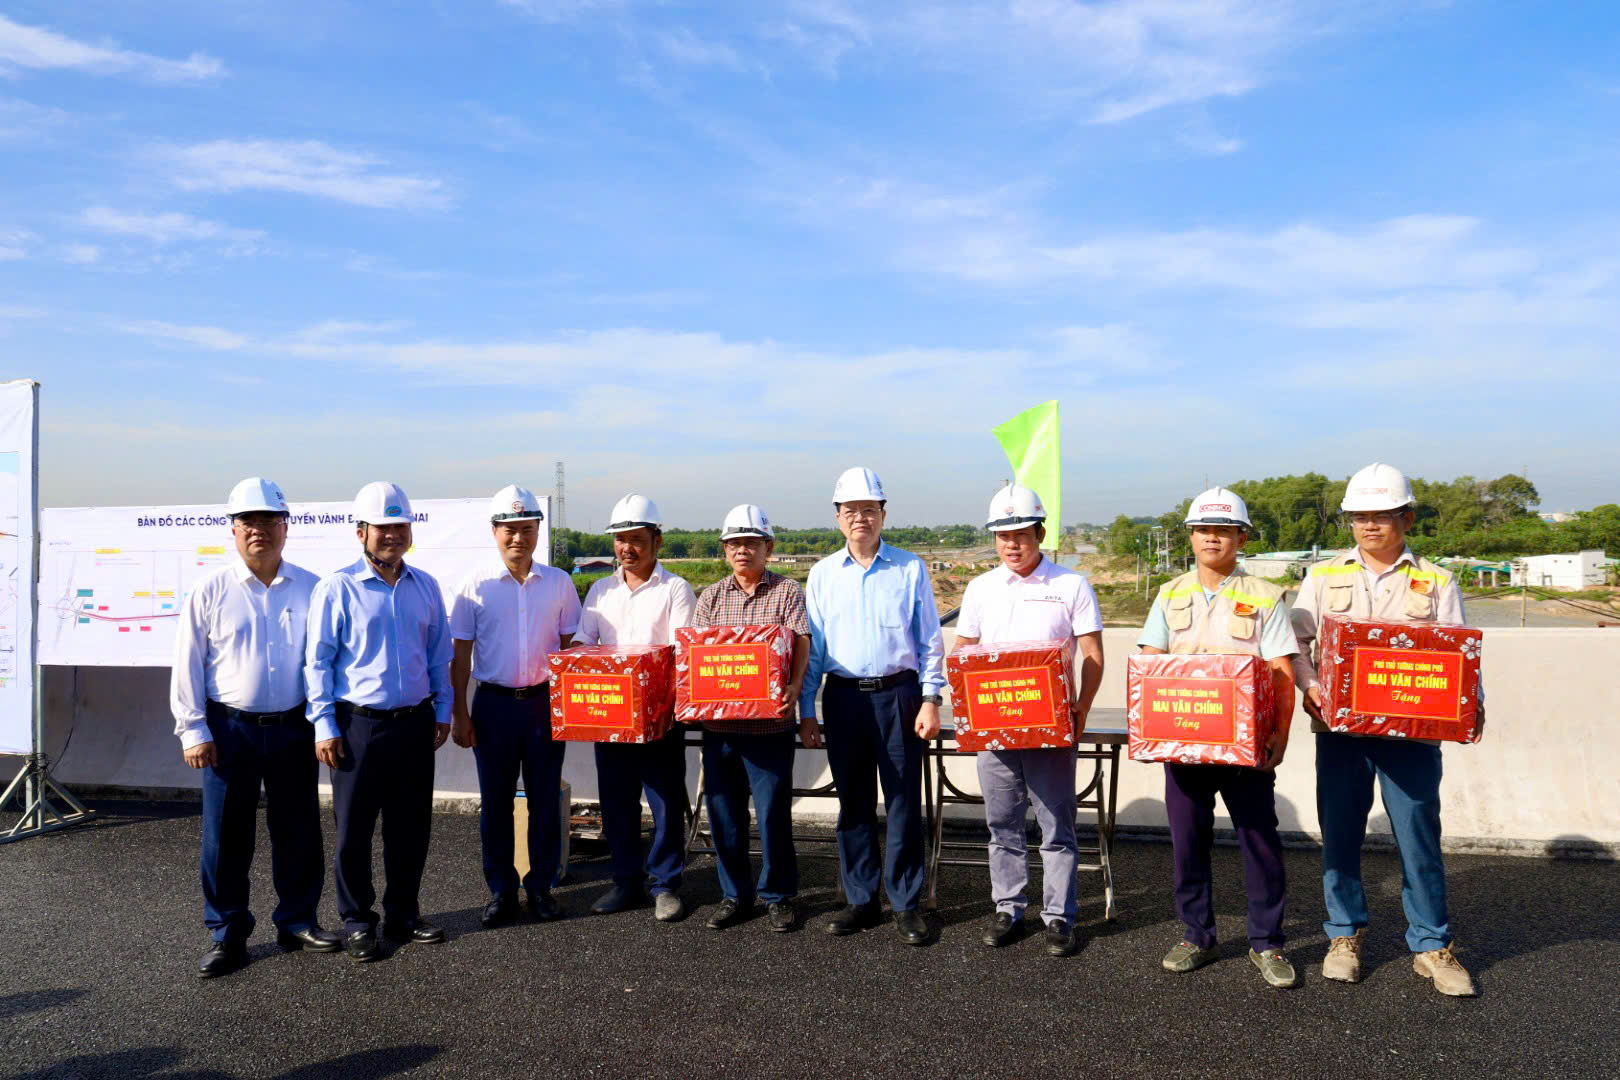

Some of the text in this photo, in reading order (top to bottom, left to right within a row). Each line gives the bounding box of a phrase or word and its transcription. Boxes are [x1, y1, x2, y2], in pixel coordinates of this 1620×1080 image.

[137, 514, 156, 527] BẢN
[159, 513, 173, 527] ĐỒ
[175, 514, 196, 527] CÁC
[198, 514, 227, 526] CÔNG
[317, 512, 345, 524] VÀNH
[700, 666, 714, 676] MAI
[735, 662, 758, 676] CHÍNH
[1368, 672, 1387, 686] MAI
[1415, 674, 1448, 689] CHÍNH
[571, 694, 584, 704] MAI
[602, 692, 624, 704] CHÍNH
[978, 693, 993, 704] MAI
[1016, 688, 1041, 702] CHÍNH
[1152, 700, 1169, 712] MAI
[1194, 700, 1222, 714] CHÍNH
